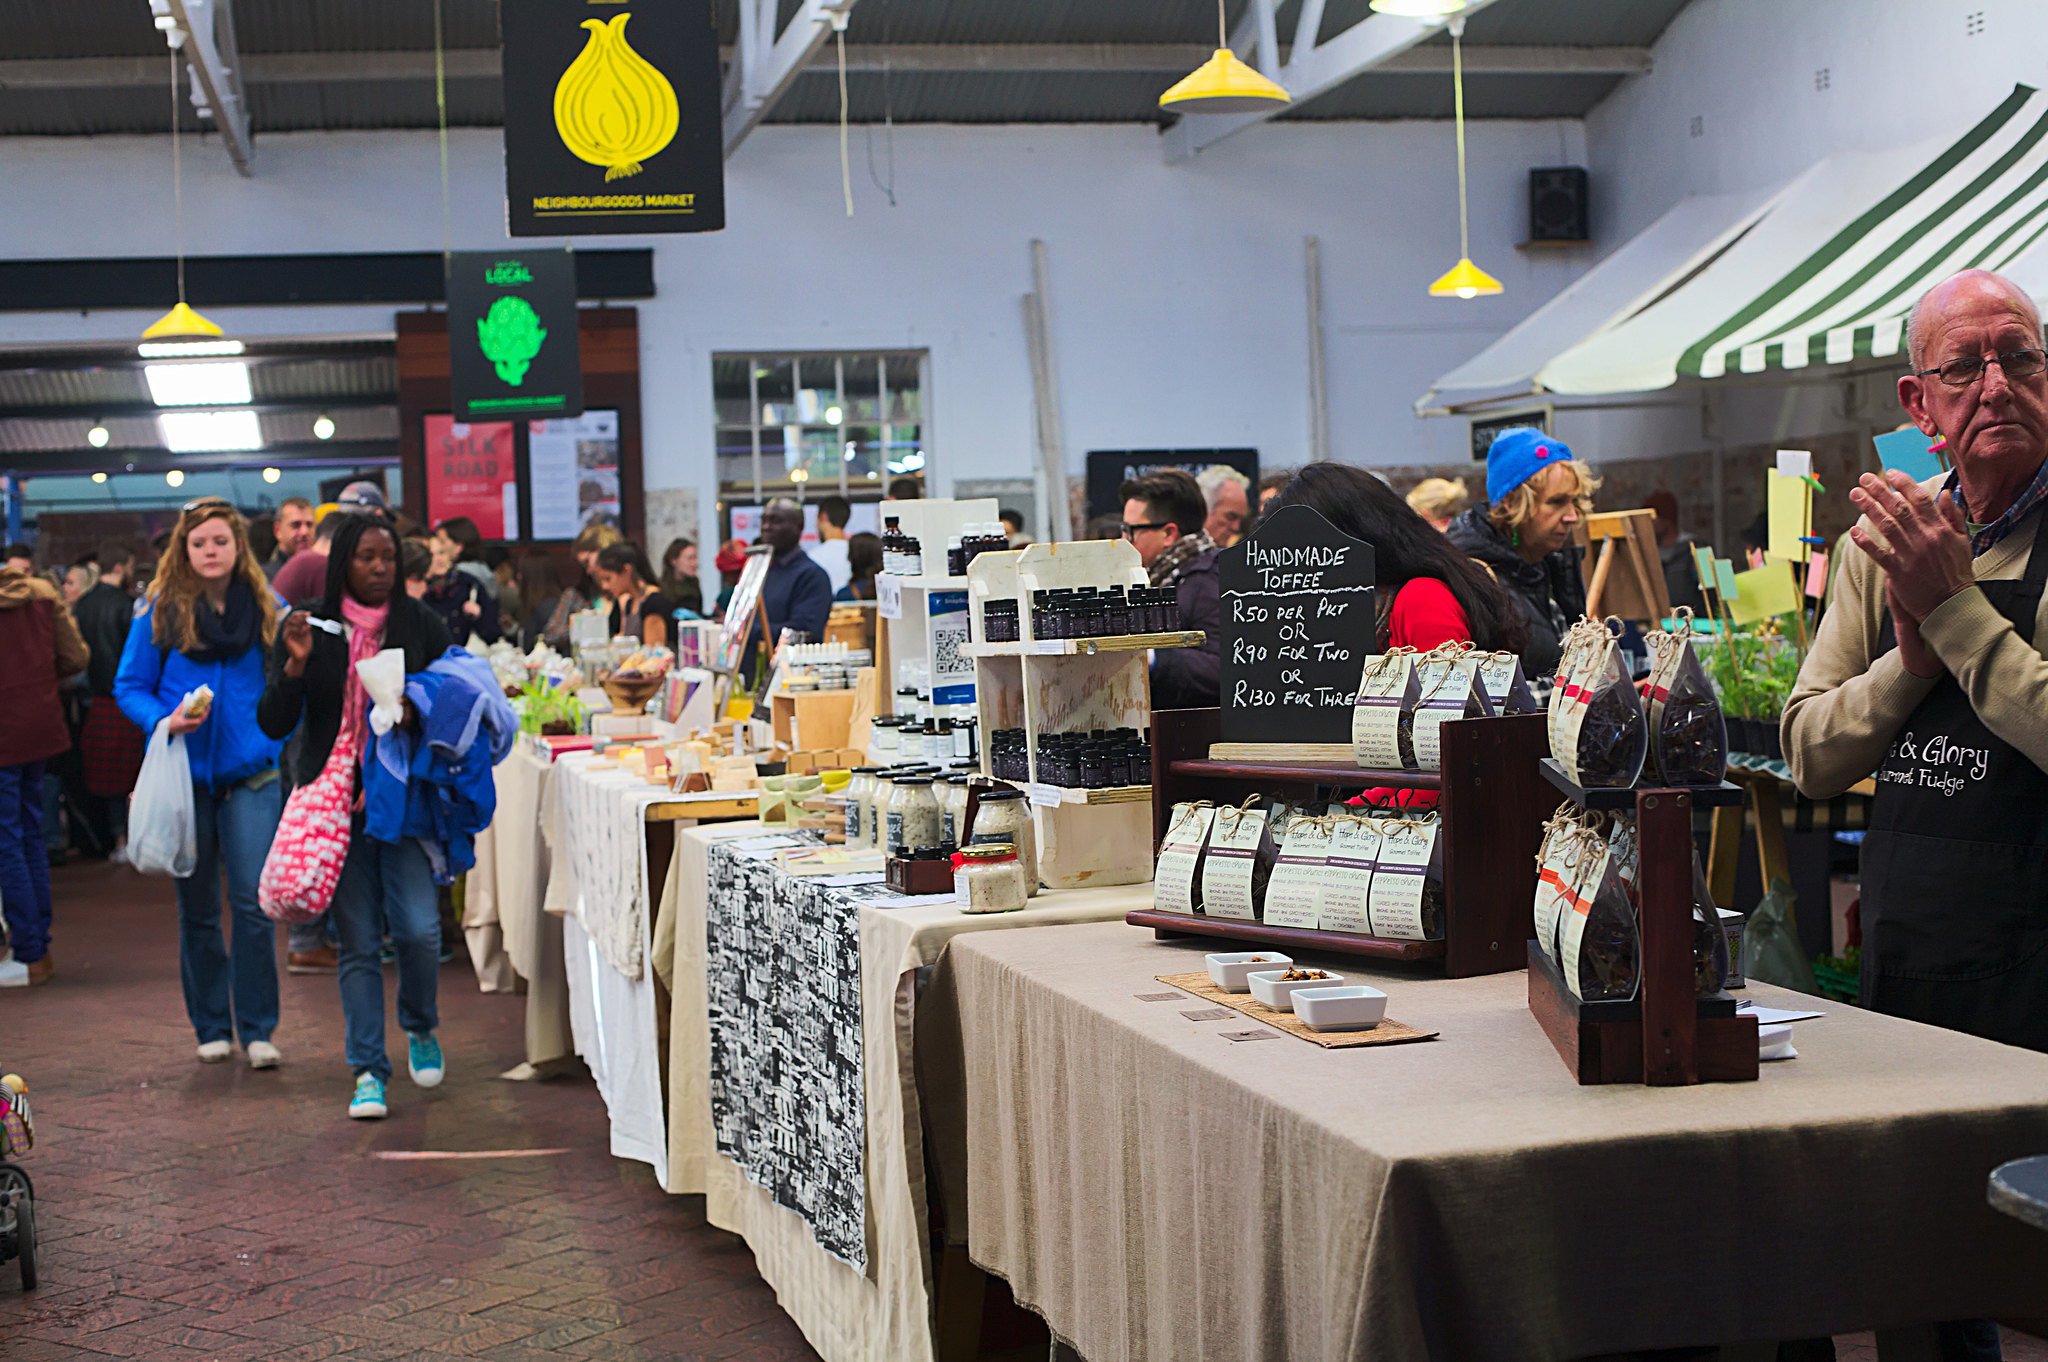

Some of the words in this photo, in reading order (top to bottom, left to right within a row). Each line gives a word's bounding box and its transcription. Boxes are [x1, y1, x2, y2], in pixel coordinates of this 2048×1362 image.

[645, 193, 696, 207] MARKET
[443, 460, 498, 479] ROAD
[1246, 540, 1350, 567] HANDMADE
[1257, 567, 1324, 589] TOFFEE
[1233, 599, 1268, 623] R50
[1277, 605, 1305, 621] PER
[1316, 597, 1348, 619] PKT
[1279, 622, 1309, 641] OR
[1232, 637, 1267, 665] R90
[1277, 645, 1309, 660] FOR
[1313, 641, 1350, 662] TWO
[1281, 668, 1304, 685] OR
[1232, 679, 1276, 708] R130
[1283, 691, 1314, 708] FOR
[1313, 687, 1356, 707] THRE
[1899, 731, 1918, 760] &
[1922, 735, 1990, 780] Glory
[1918, 768, 1965, 797] Fudge
